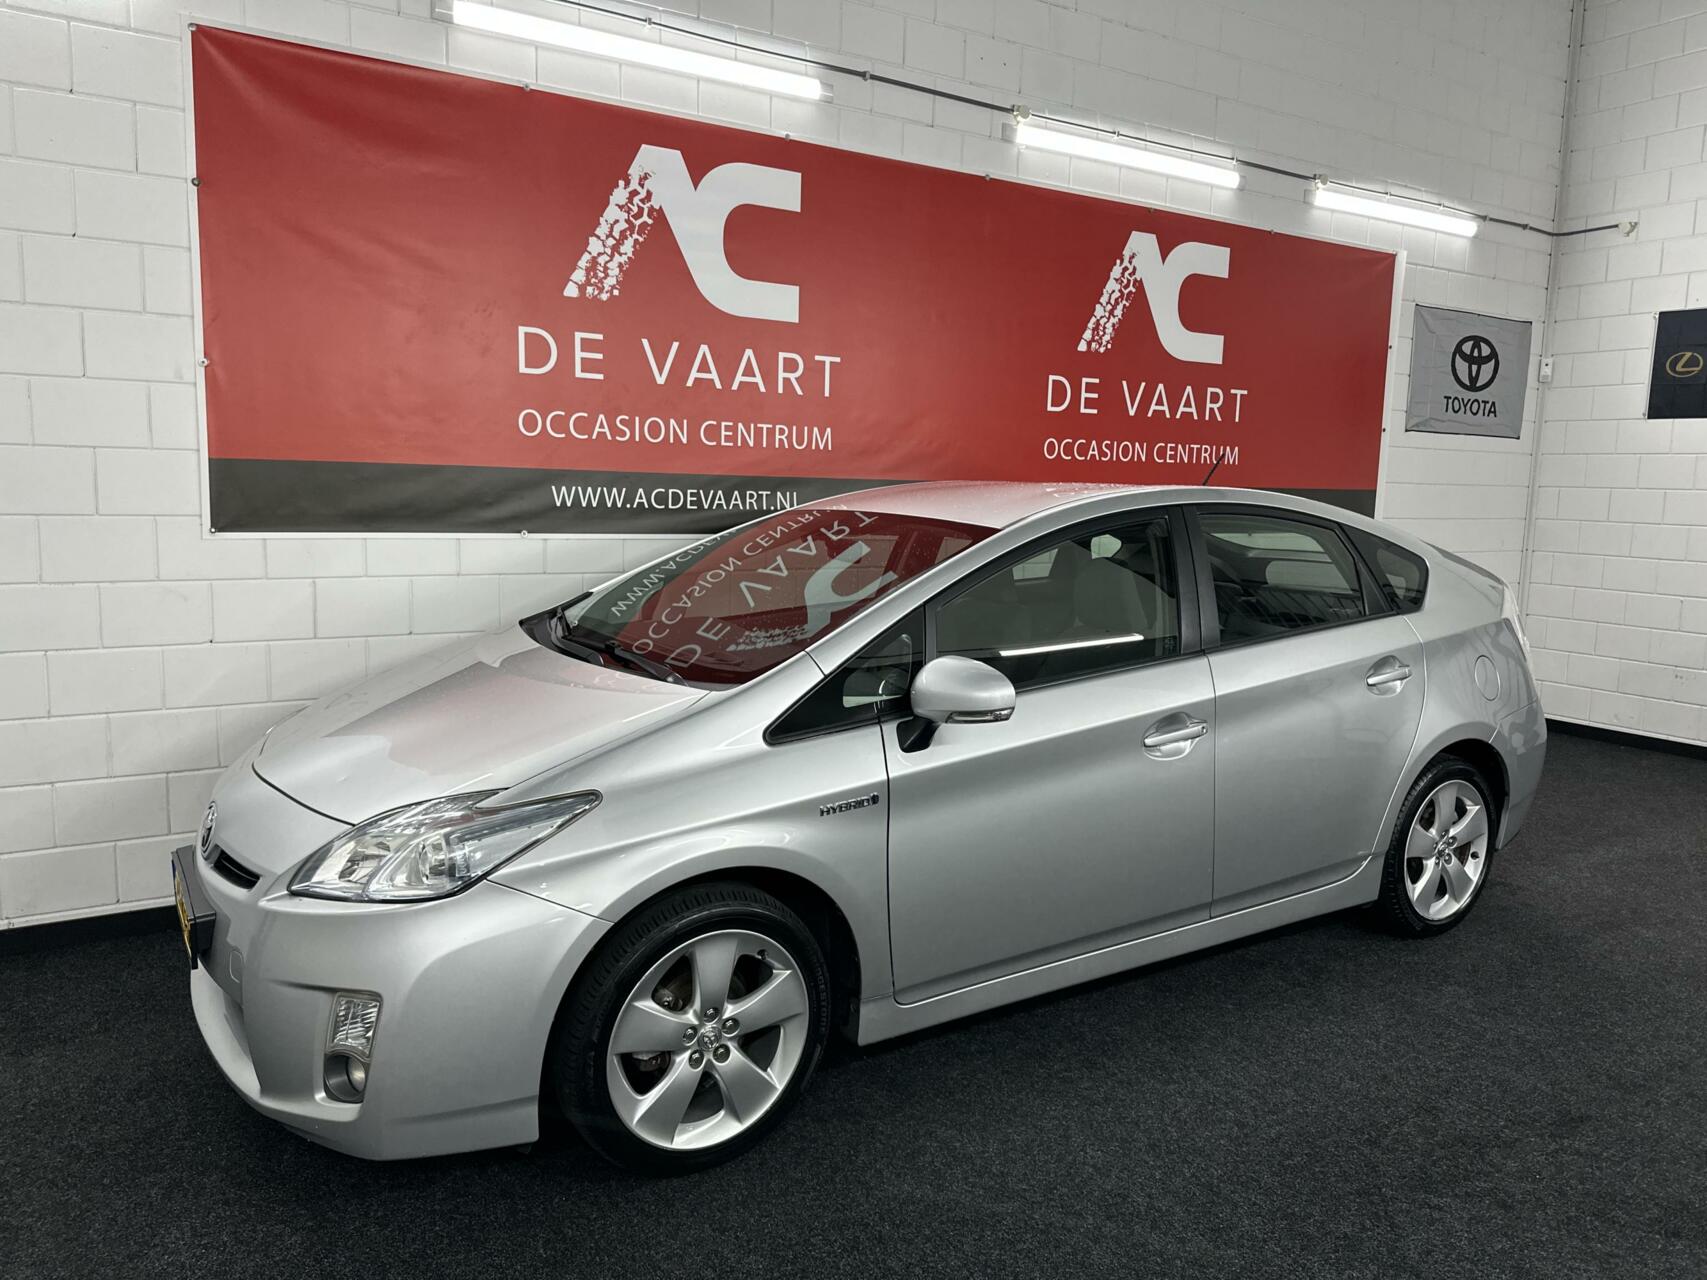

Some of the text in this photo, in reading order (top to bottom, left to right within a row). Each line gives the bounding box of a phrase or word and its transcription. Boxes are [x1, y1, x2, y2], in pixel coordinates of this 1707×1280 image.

[563, 144, 802, 324] AC
[1077, 230, 1231, 365] AC
[517, 325, 842, 398] DE VAART
[1046, 374, 1248, 423] DE VAART
[1443, 395, 1498, 418] TOYOTA
[517, 408, 833, 451] OCCASION CENTRUM
[1043, 437, 1239, 465] OCCASION CENTRUM
[819, 796, 871, 817] HYBRID
